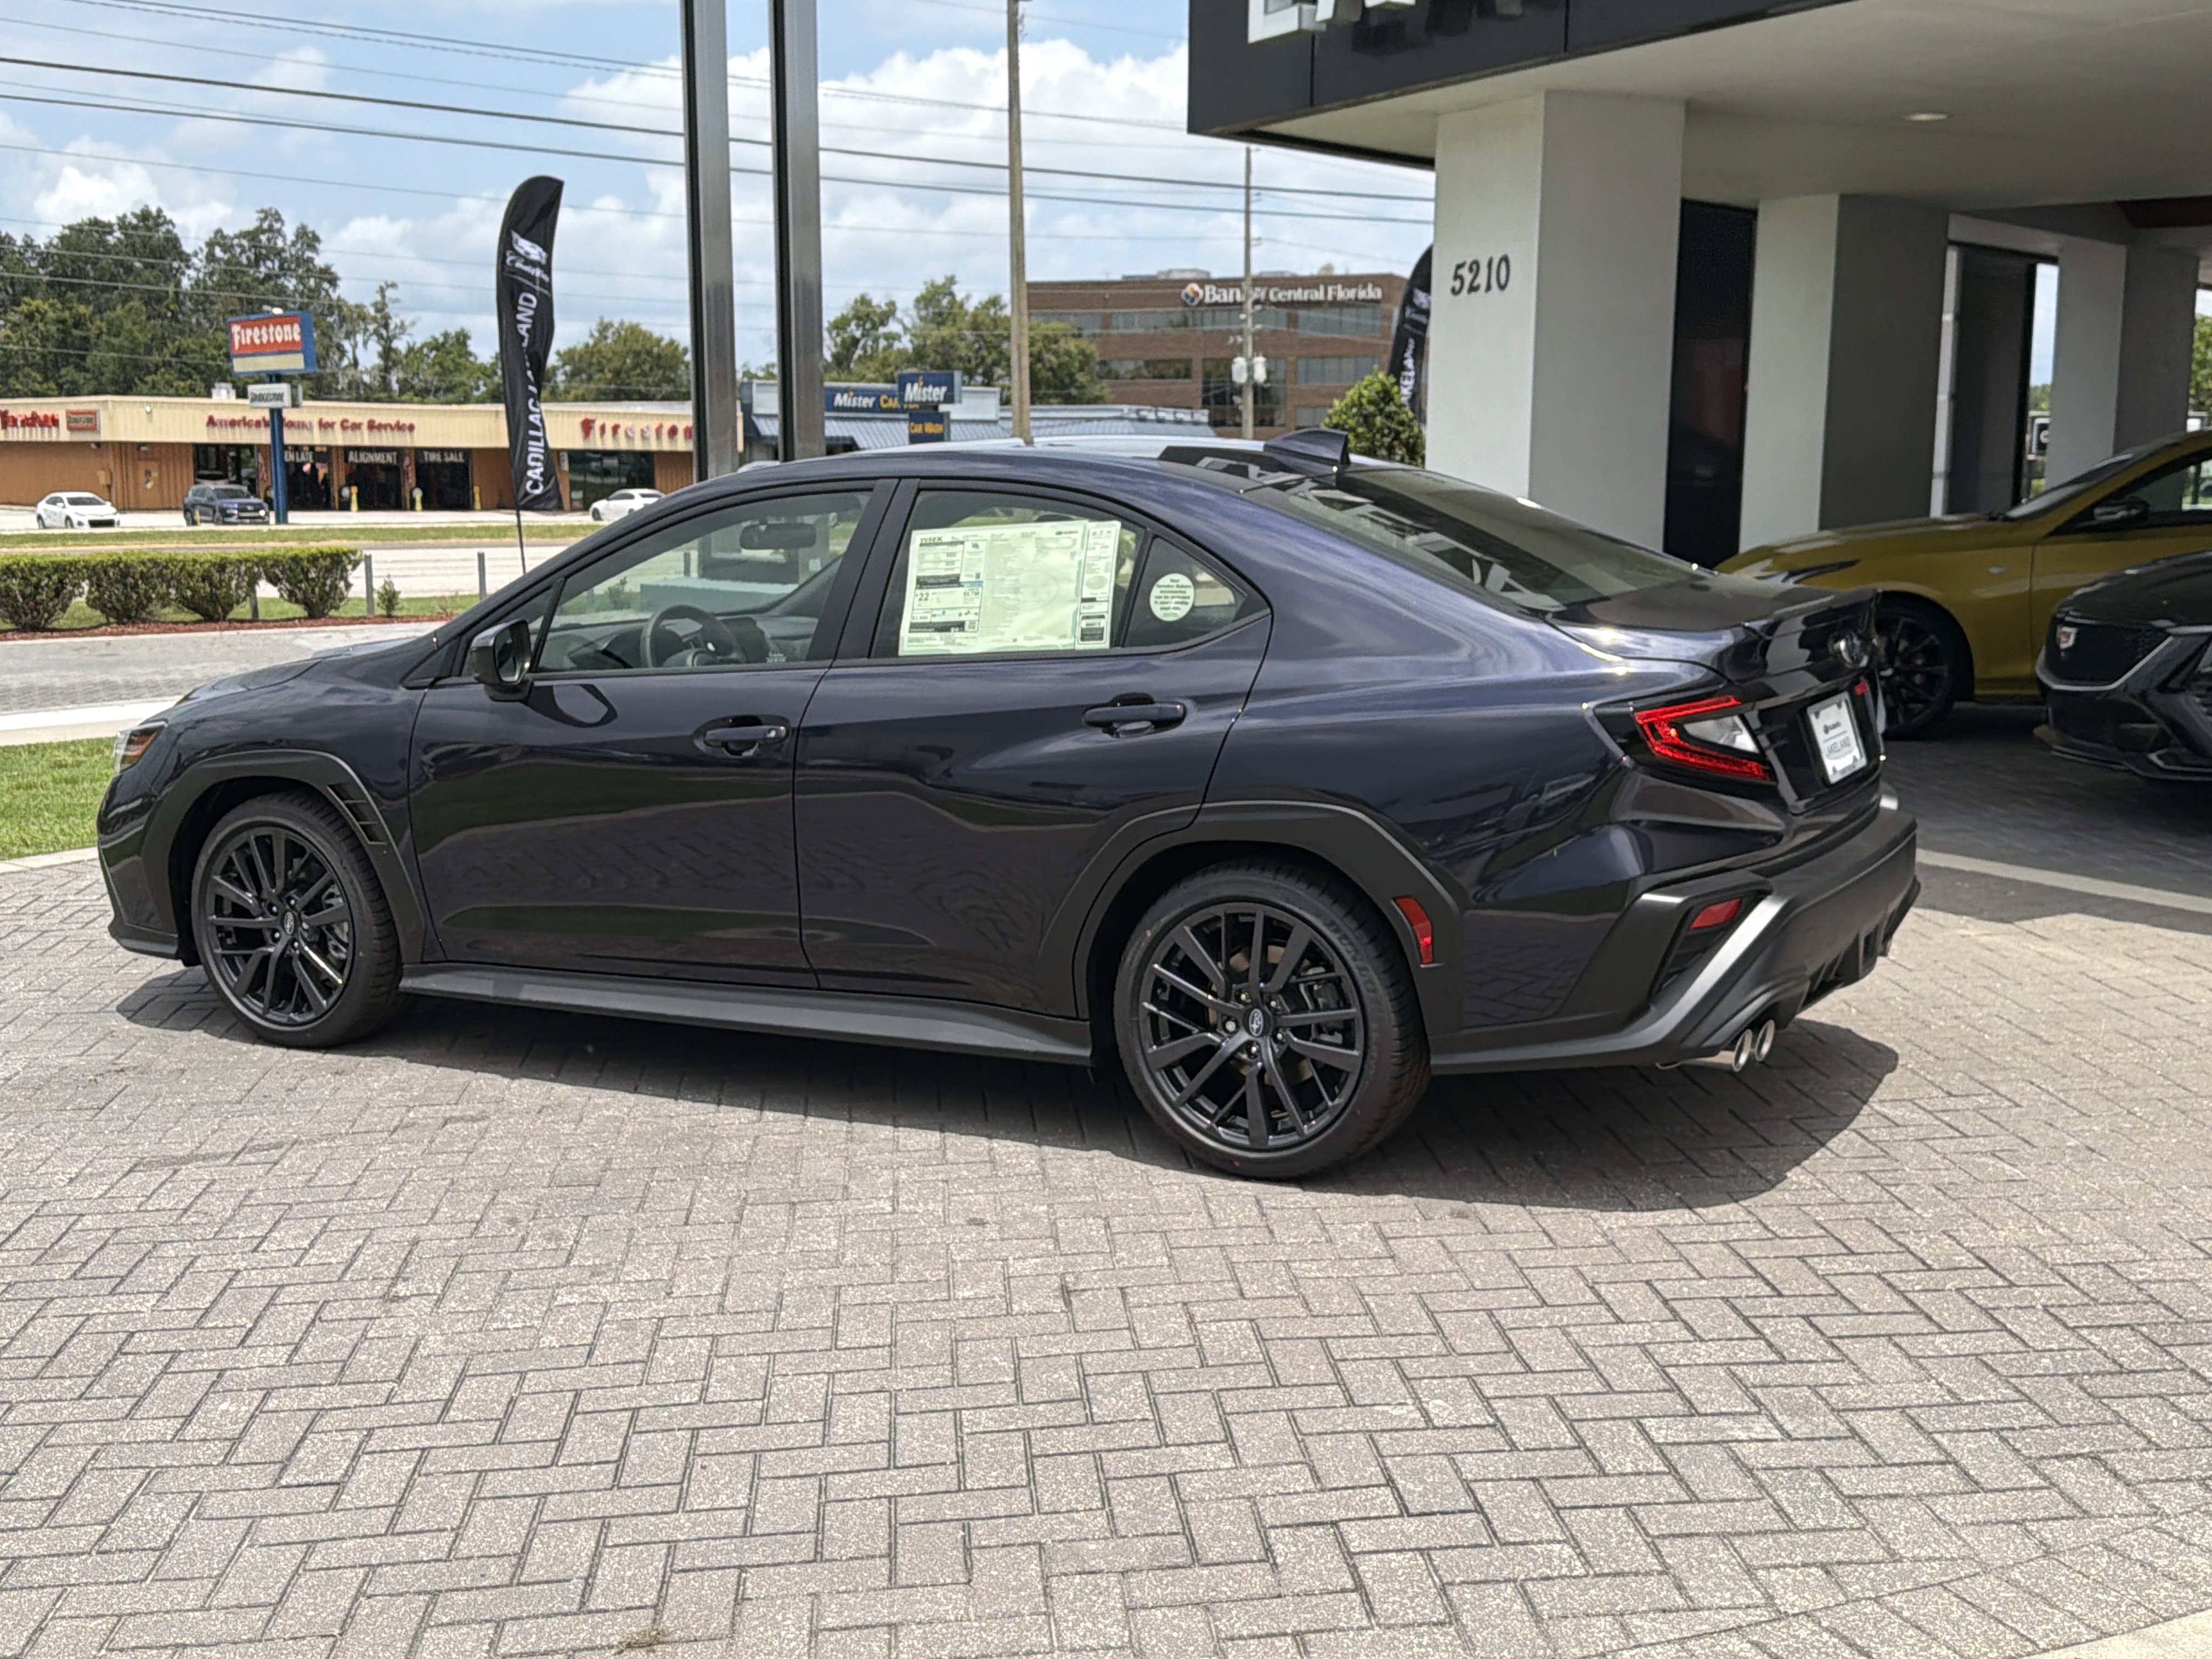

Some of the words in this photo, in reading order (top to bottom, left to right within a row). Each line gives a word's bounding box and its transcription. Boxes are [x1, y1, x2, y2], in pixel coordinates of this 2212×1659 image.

[1450, 253, 1510, 296] 5210
[1268, 284, 1325, 302] Central
[1327, 282, 1383, 301] Florida
[231, 323, 301, 351] Firestone
[833, 390, 876, 409] Mister
[904, 380, 947, 403] Mister
[318, 417, 336, 431] for
[340, 418, 364, 431] Car
[367, 418, 416, 433] Service
[348, 450, 398, 465] ALIGNMENT
[918, 592, 930, 601] 22
